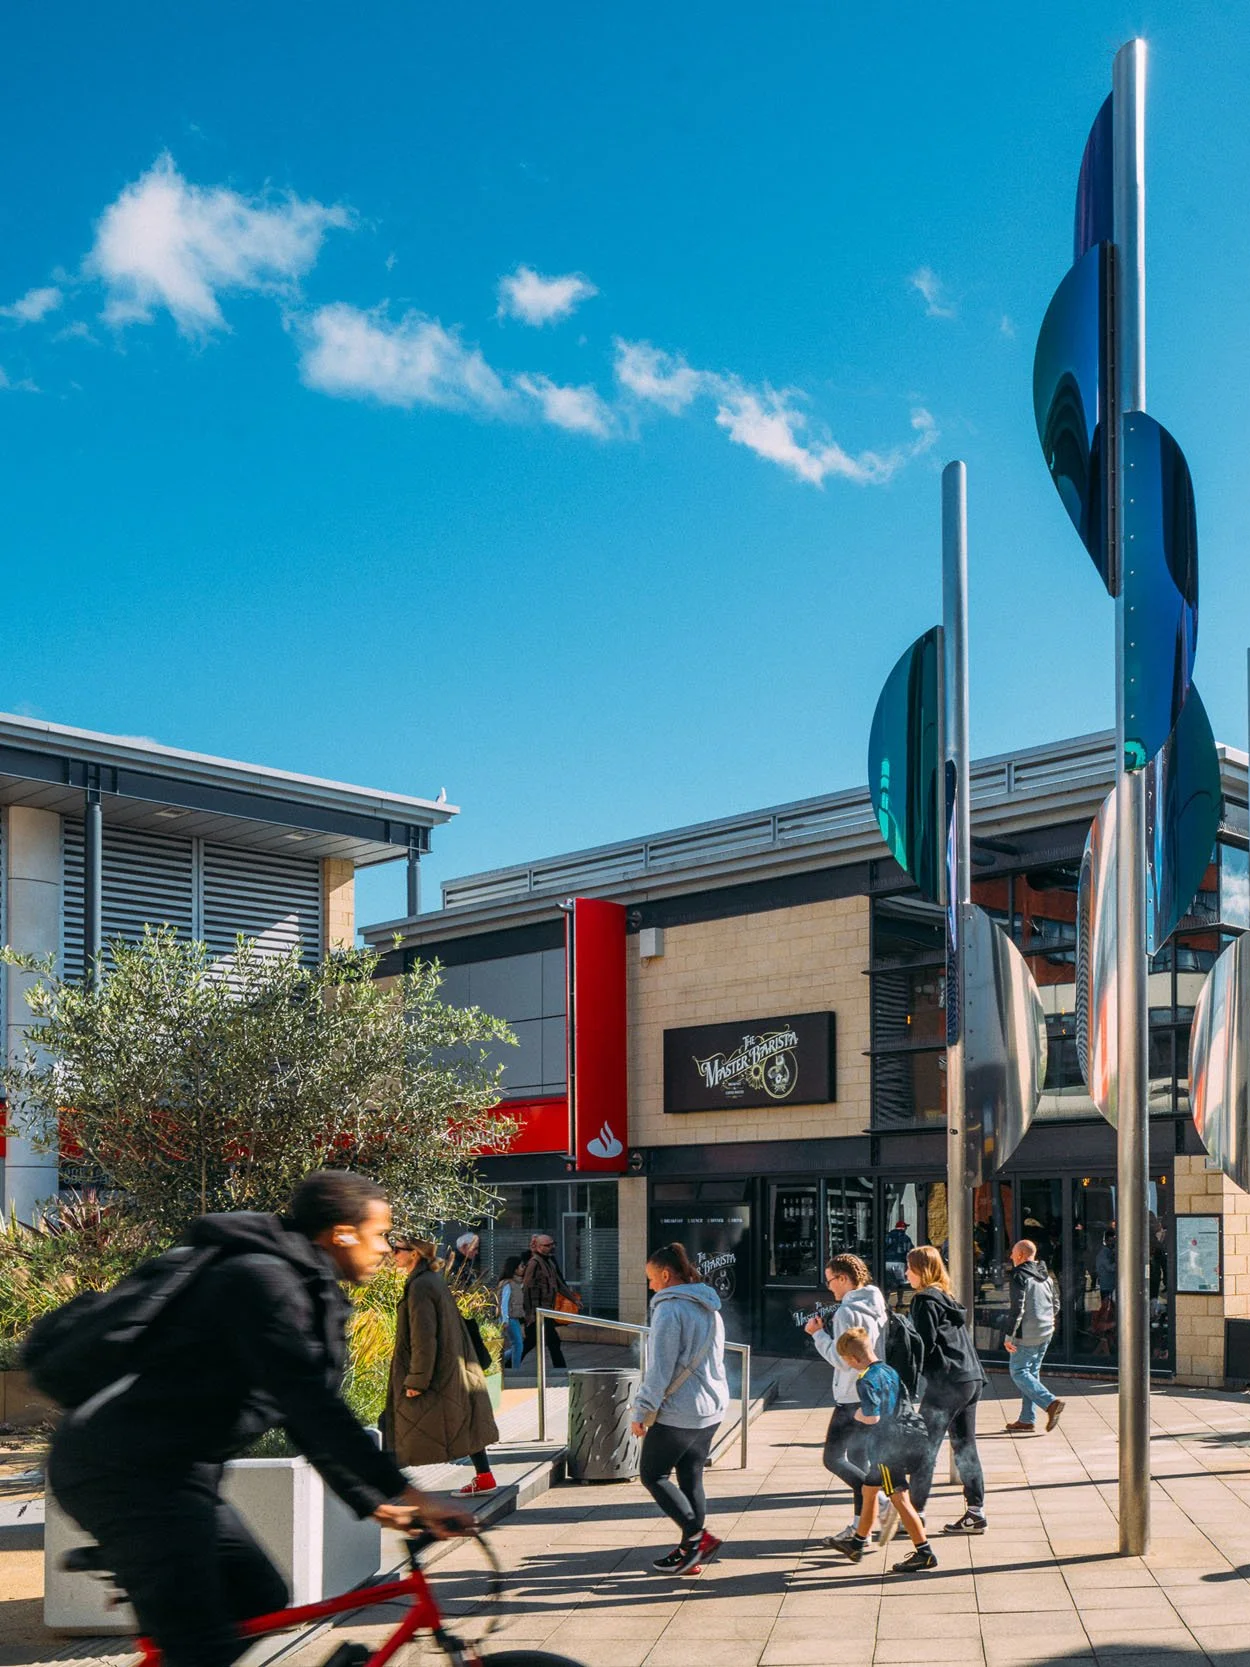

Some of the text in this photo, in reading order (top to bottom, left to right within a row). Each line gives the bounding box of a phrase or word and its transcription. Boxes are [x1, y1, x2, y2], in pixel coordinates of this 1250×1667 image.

[742, 1035, 755, 1051] THE
[701, 1031, 799, 1088] MASTER BARISTA
[701, 1253, 737, 1275] BARISTA
